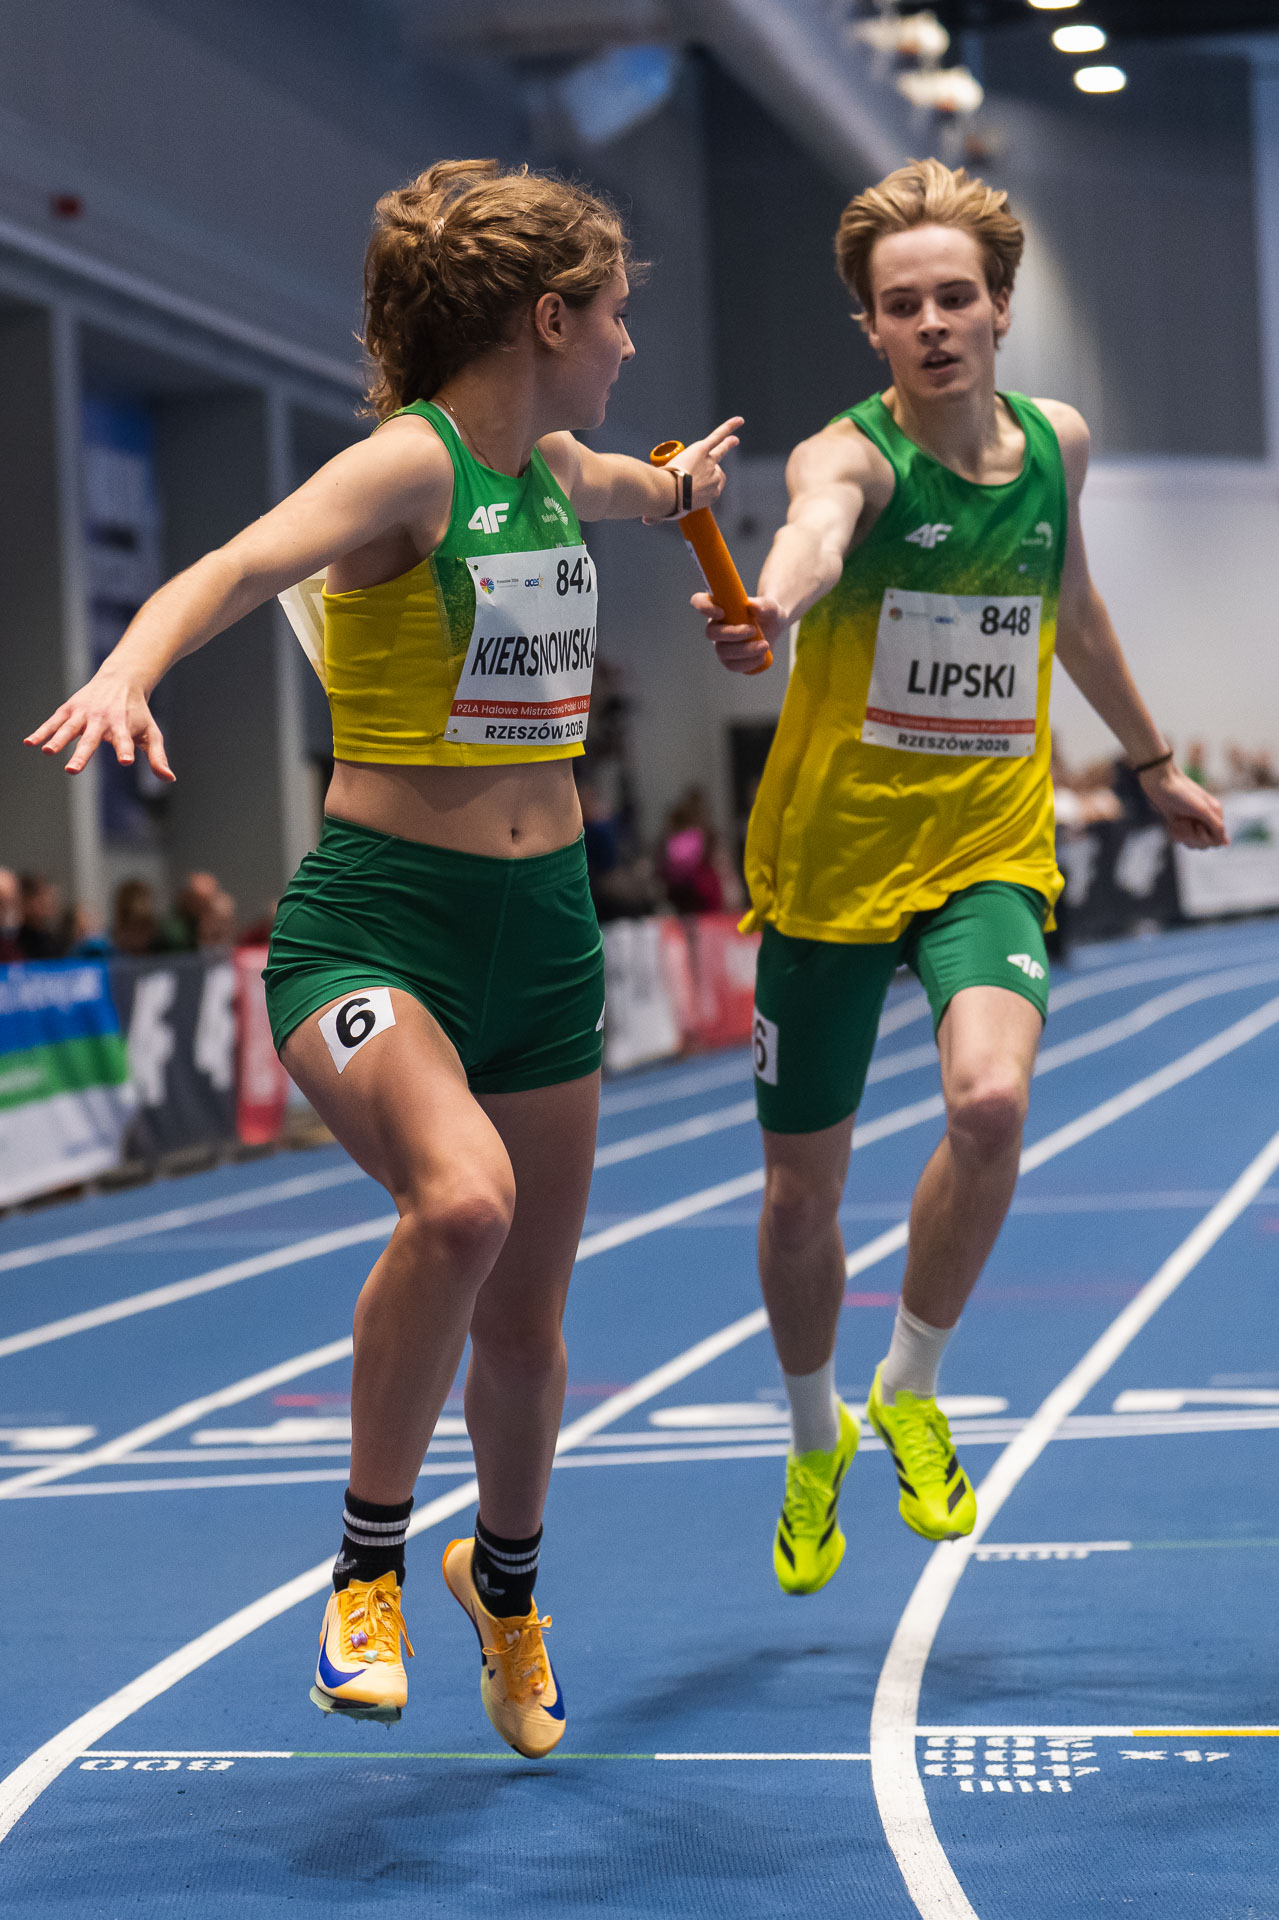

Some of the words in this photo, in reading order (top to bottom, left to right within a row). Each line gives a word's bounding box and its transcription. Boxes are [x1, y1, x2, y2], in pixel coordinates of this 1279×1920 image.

[468, 502, 510, 535] 4F
[980, 605, 1031, 637] 848
[906, 659, 1016, 699] LIPSKI
[456, 703, 479, 714] PZLA
[481, 705, 519, 716] Halowe
[520, 704, 564, 717] Mistrzostwa
[485, 722, 564, 740] RZESZÓW
[565, 719, 584, 738] 2026
[897, 731, 974, 752] RZESZÓW
[975, 738, 1010, 752] 2026
[336, 997, 376, 1049] 6
[79, 1759, 235, 1772] 800
